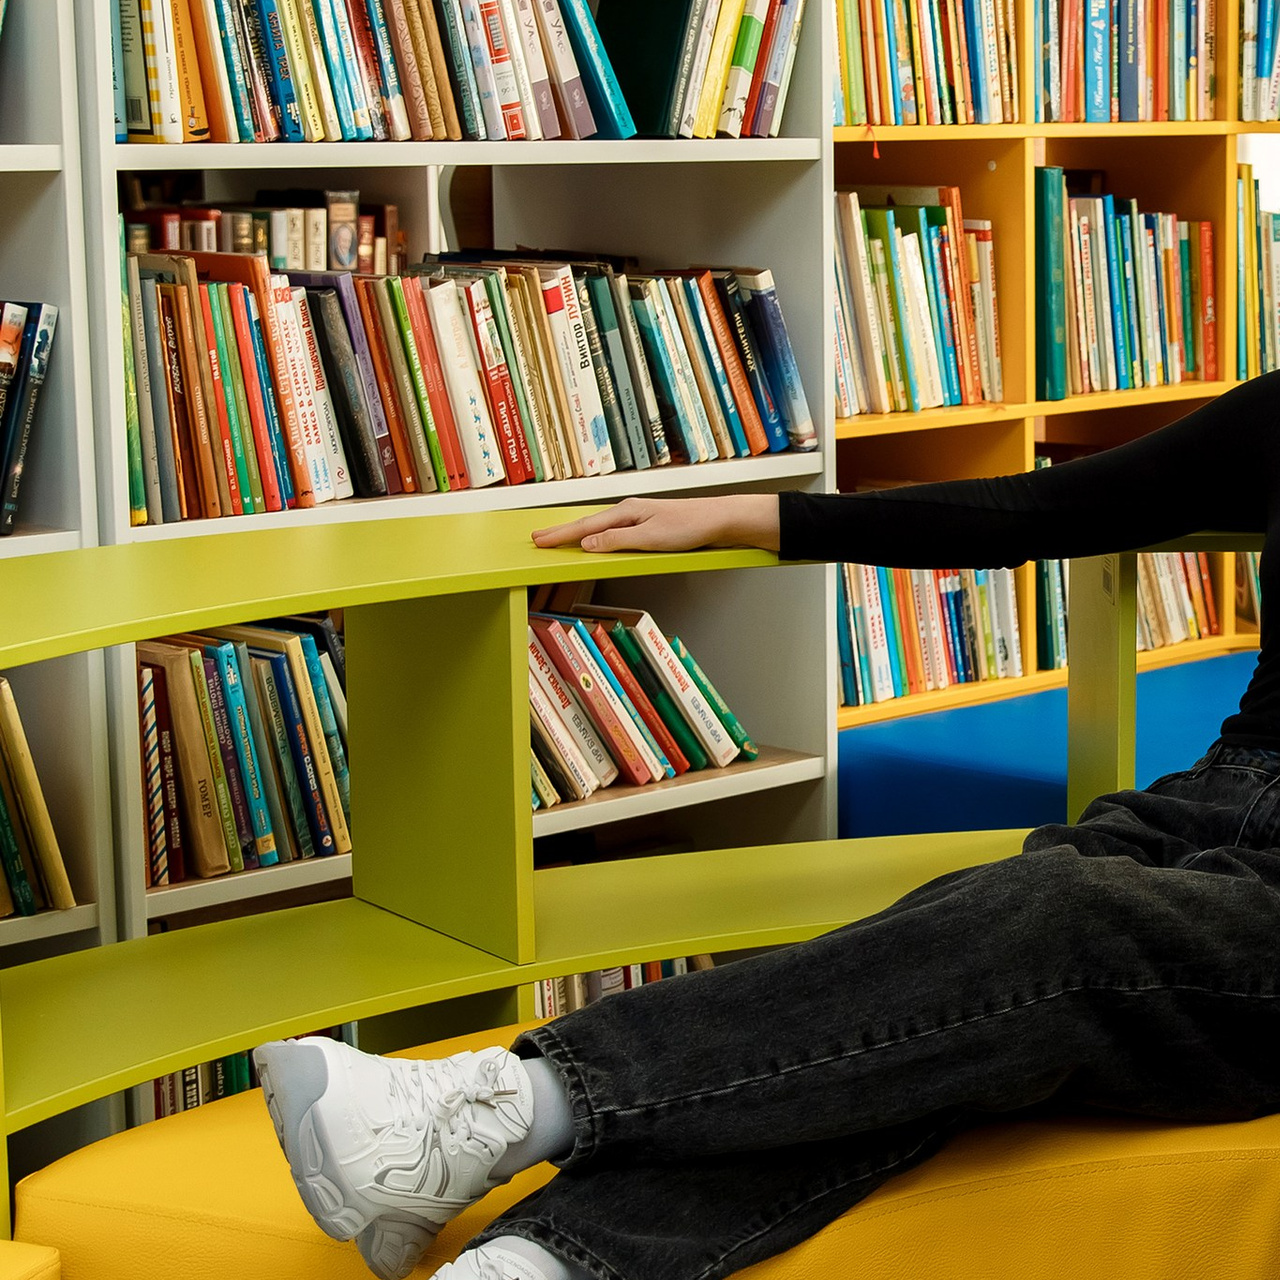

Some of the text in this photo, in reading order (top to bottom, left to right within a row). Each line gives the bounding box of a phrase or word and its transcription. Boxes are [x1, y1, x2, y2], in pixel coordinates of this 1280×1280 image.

[268, 11, 283, 49] КНИГА
[560, 275, 590, 369] Виктор ЛУНИН
[734, 312, 755, 371] ХРАНИТЕЛИ
[306, 329, 326, 391] Приключения
[549, 674, 572, 710] Девочка
[667, 660, 690, 693] Девочка
[207, 678, 227, 744] СЫЩИКИ ПРОТИВ
[198, 779, 212, 818] ГОМЕР
